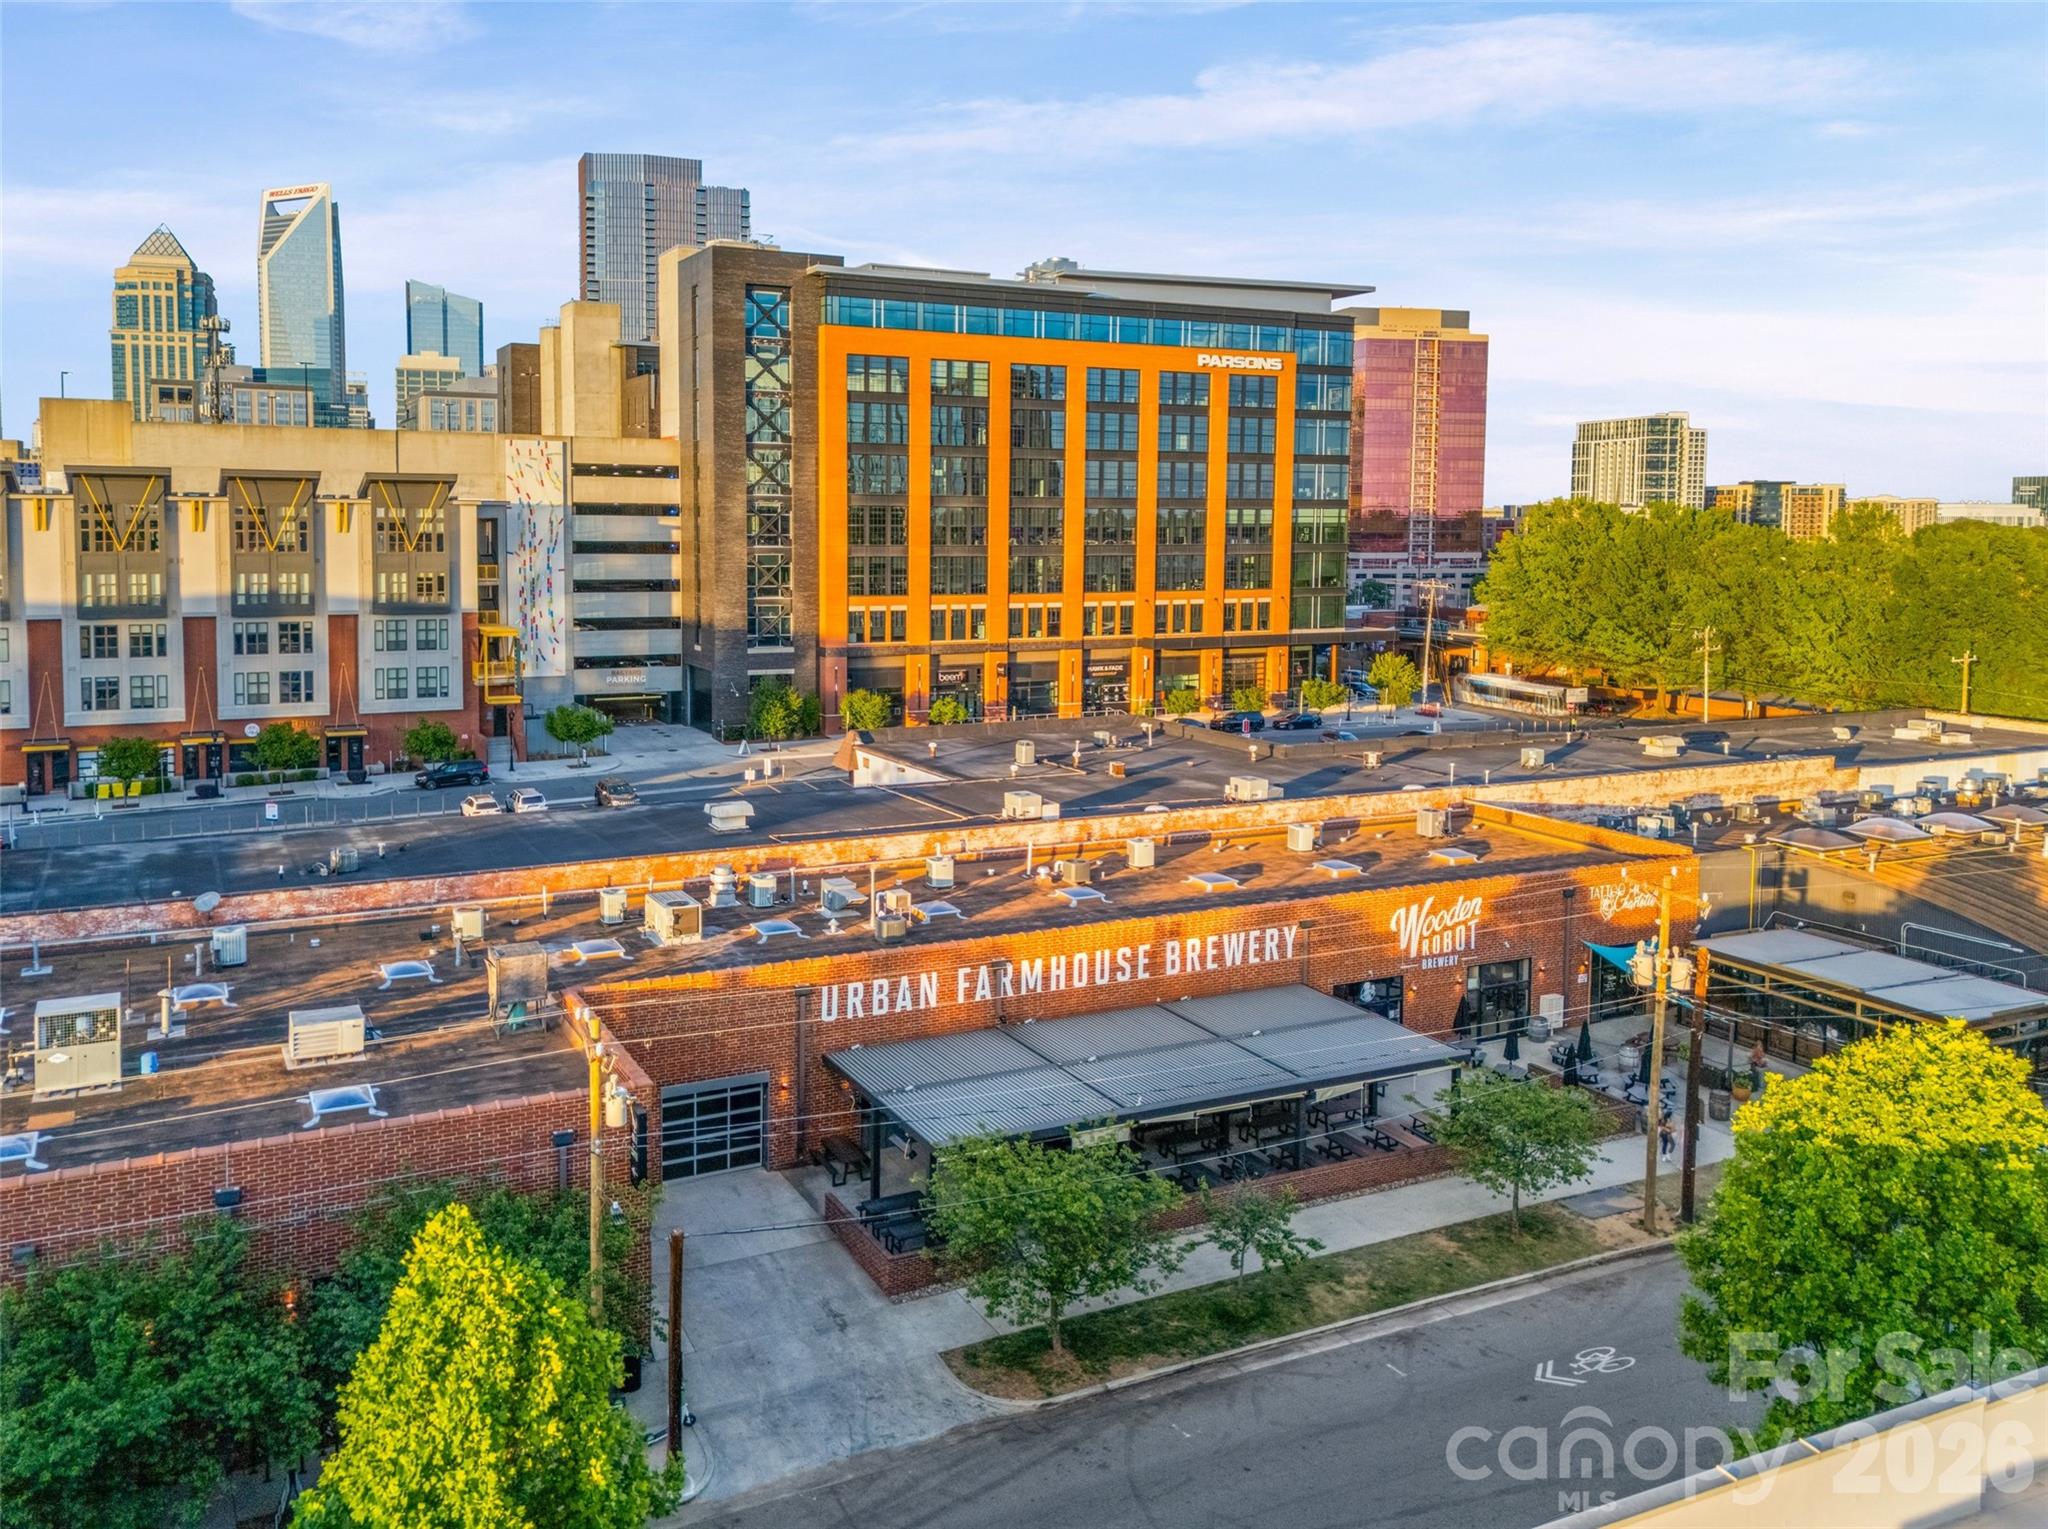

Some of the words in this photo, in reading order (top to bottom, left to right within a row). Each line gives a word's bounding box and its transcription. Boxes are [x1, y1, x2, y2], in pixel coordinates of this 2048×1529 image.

[1198, 354, 1282, 370] PARSONS
[606, 675, 647, 683] PARKING
[1390, 895, 1482, 958] Wooden
[1422, 919, 1479, 955] ROBOT
[820, 972, 938, 1022] URBAN
[957, 944, 1151, 1004] FARMHOUSE
[1166, 925, 1298, 976] BREWERY
[1422, 955, 1458, 969] BREWERY
